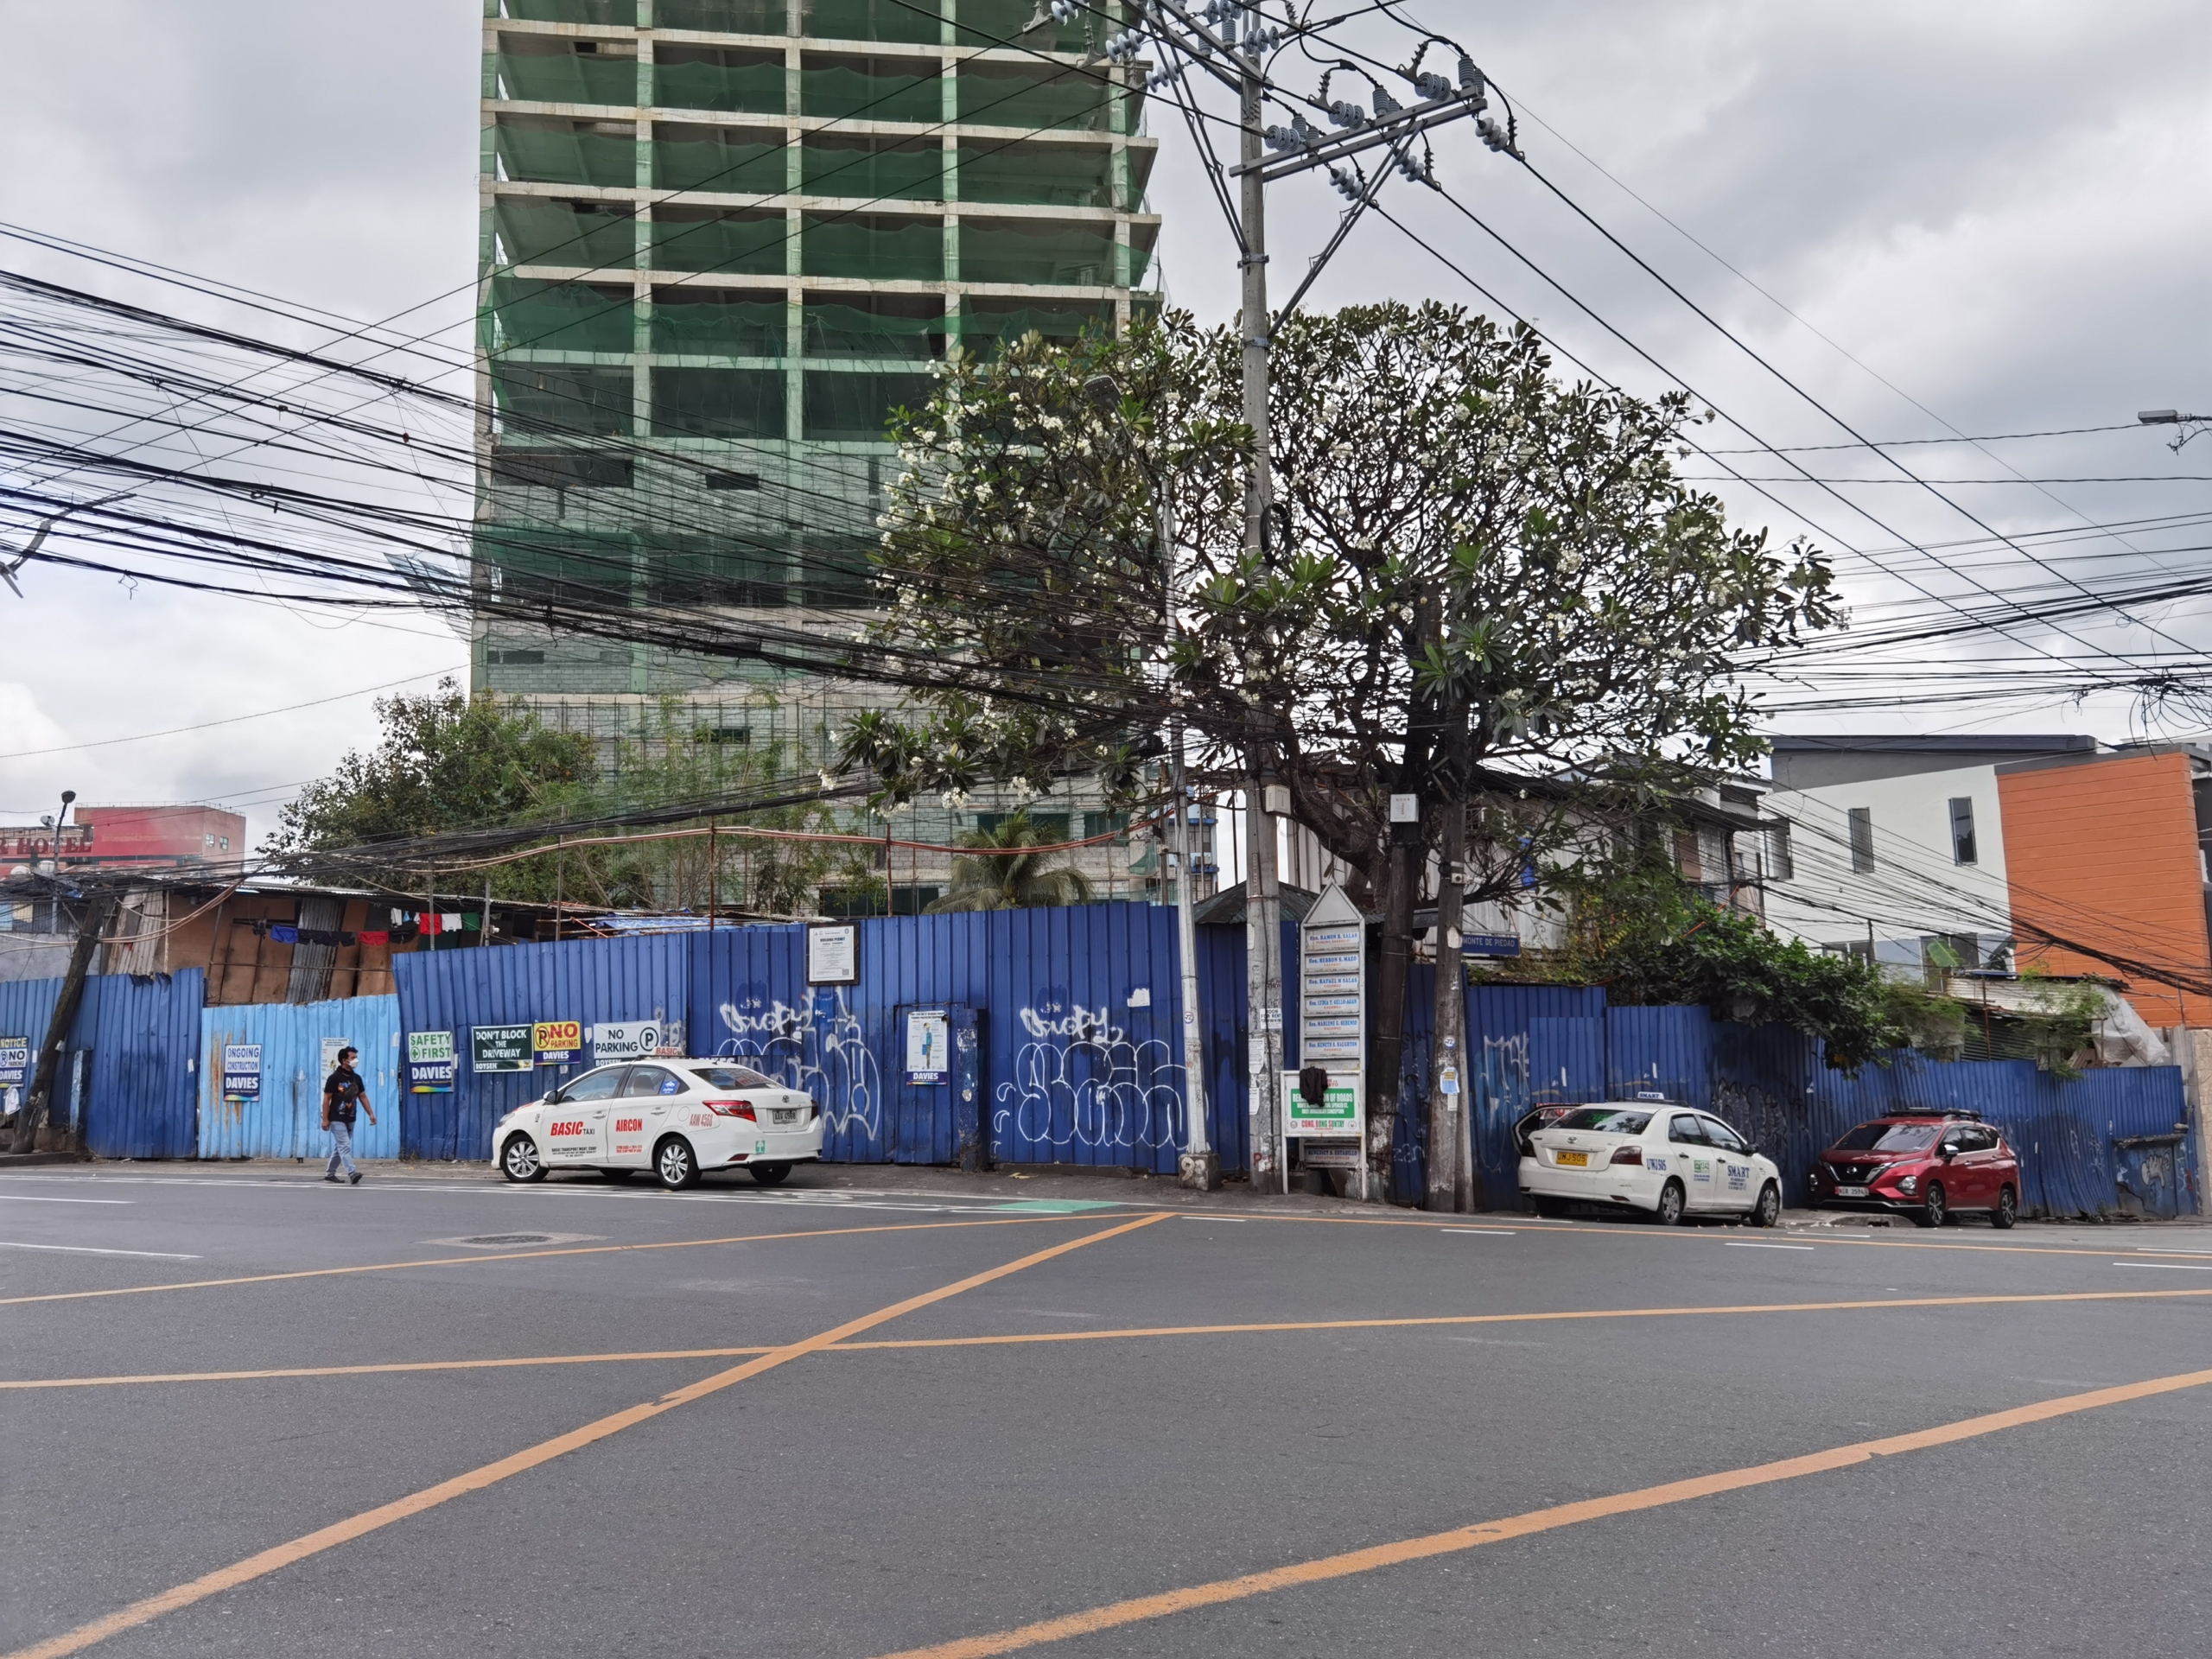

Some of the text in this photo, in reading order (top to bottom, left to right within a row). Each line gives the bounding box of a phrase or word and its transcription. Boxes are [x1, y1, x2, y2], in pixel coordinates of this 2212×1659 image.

[1463, 937, 1483, 946] MONTE
[1494, 939, 1515, 947] PIEDAD
[476, 1029, 527, 1040] DON'T BLOCK
[550, 1023, 578, 1039] NO
[608, 1029, 624, 1040] NO
[0, 1037, 27, 1048] NOTICE
[410, 1033, 451, 1046] SAFETY
[550, 1039, 578, 1049] PARKING
[595, 1041, 638, 1053] PARKING
[9, 1051, 25, 1060] NO
[228, 1048, 259, 1058] ONGOING
[422, 1047, 450, 1059] FIRST
[482, 1048, 521, 1058] DRIVEWAY
[543, 1051, 569, 1060] DAVIES
[227, 1061, 258, 1070] CONSTRUCTION
[0, 1070, 23, 1080] DAVIES
[412, 1066, 452, 1080] DAVIES
[226, 1077, 258, 1089] DAVIES
[1337, 1093, 1353, 1102] ROADS
[550, 1121, 583, 1136] BASIC
[616, 1119, 643, 1132] AIRCON
[1558, 1152, 1586, 1162] UWJ 505
[1728, 1165, 1750, 1178] SMART
